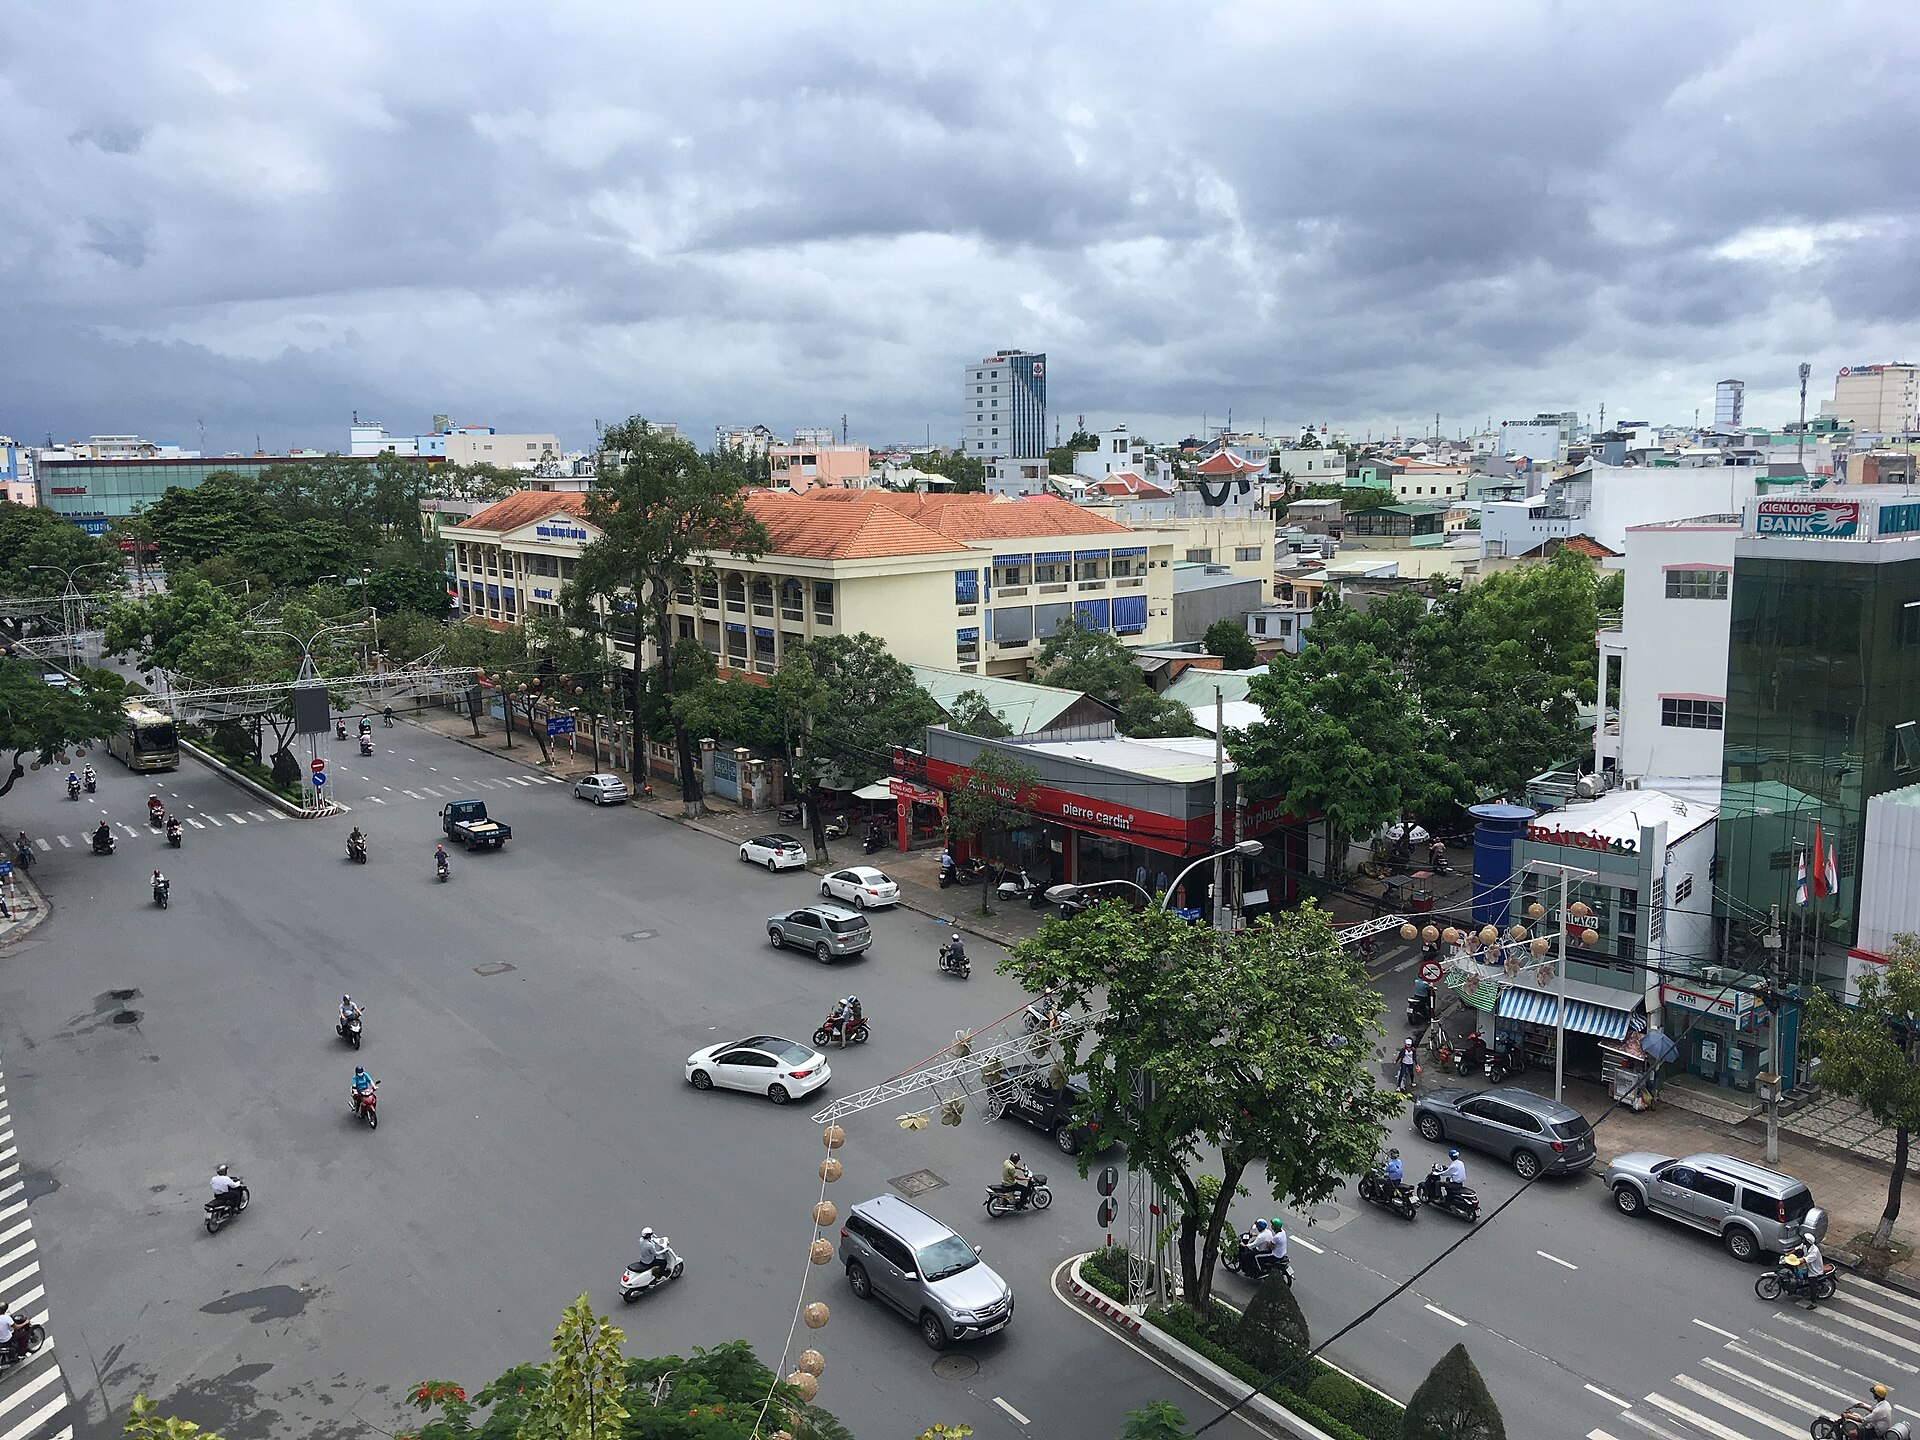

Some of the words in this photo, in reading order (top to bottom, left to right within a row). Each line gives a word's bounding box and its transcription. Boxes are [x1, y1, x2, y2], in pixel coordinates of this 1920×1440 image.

[1760, 504, 1817, 514] KIENLONG
[1760, 516, 1814, 533] BANK
[1062, 802, 1094, 819] pierre
[1095, 812, 1130, 830] cardin
[1611, 838, 1637, 857] 42
[1676, 992, 1697, 1005] ATM
